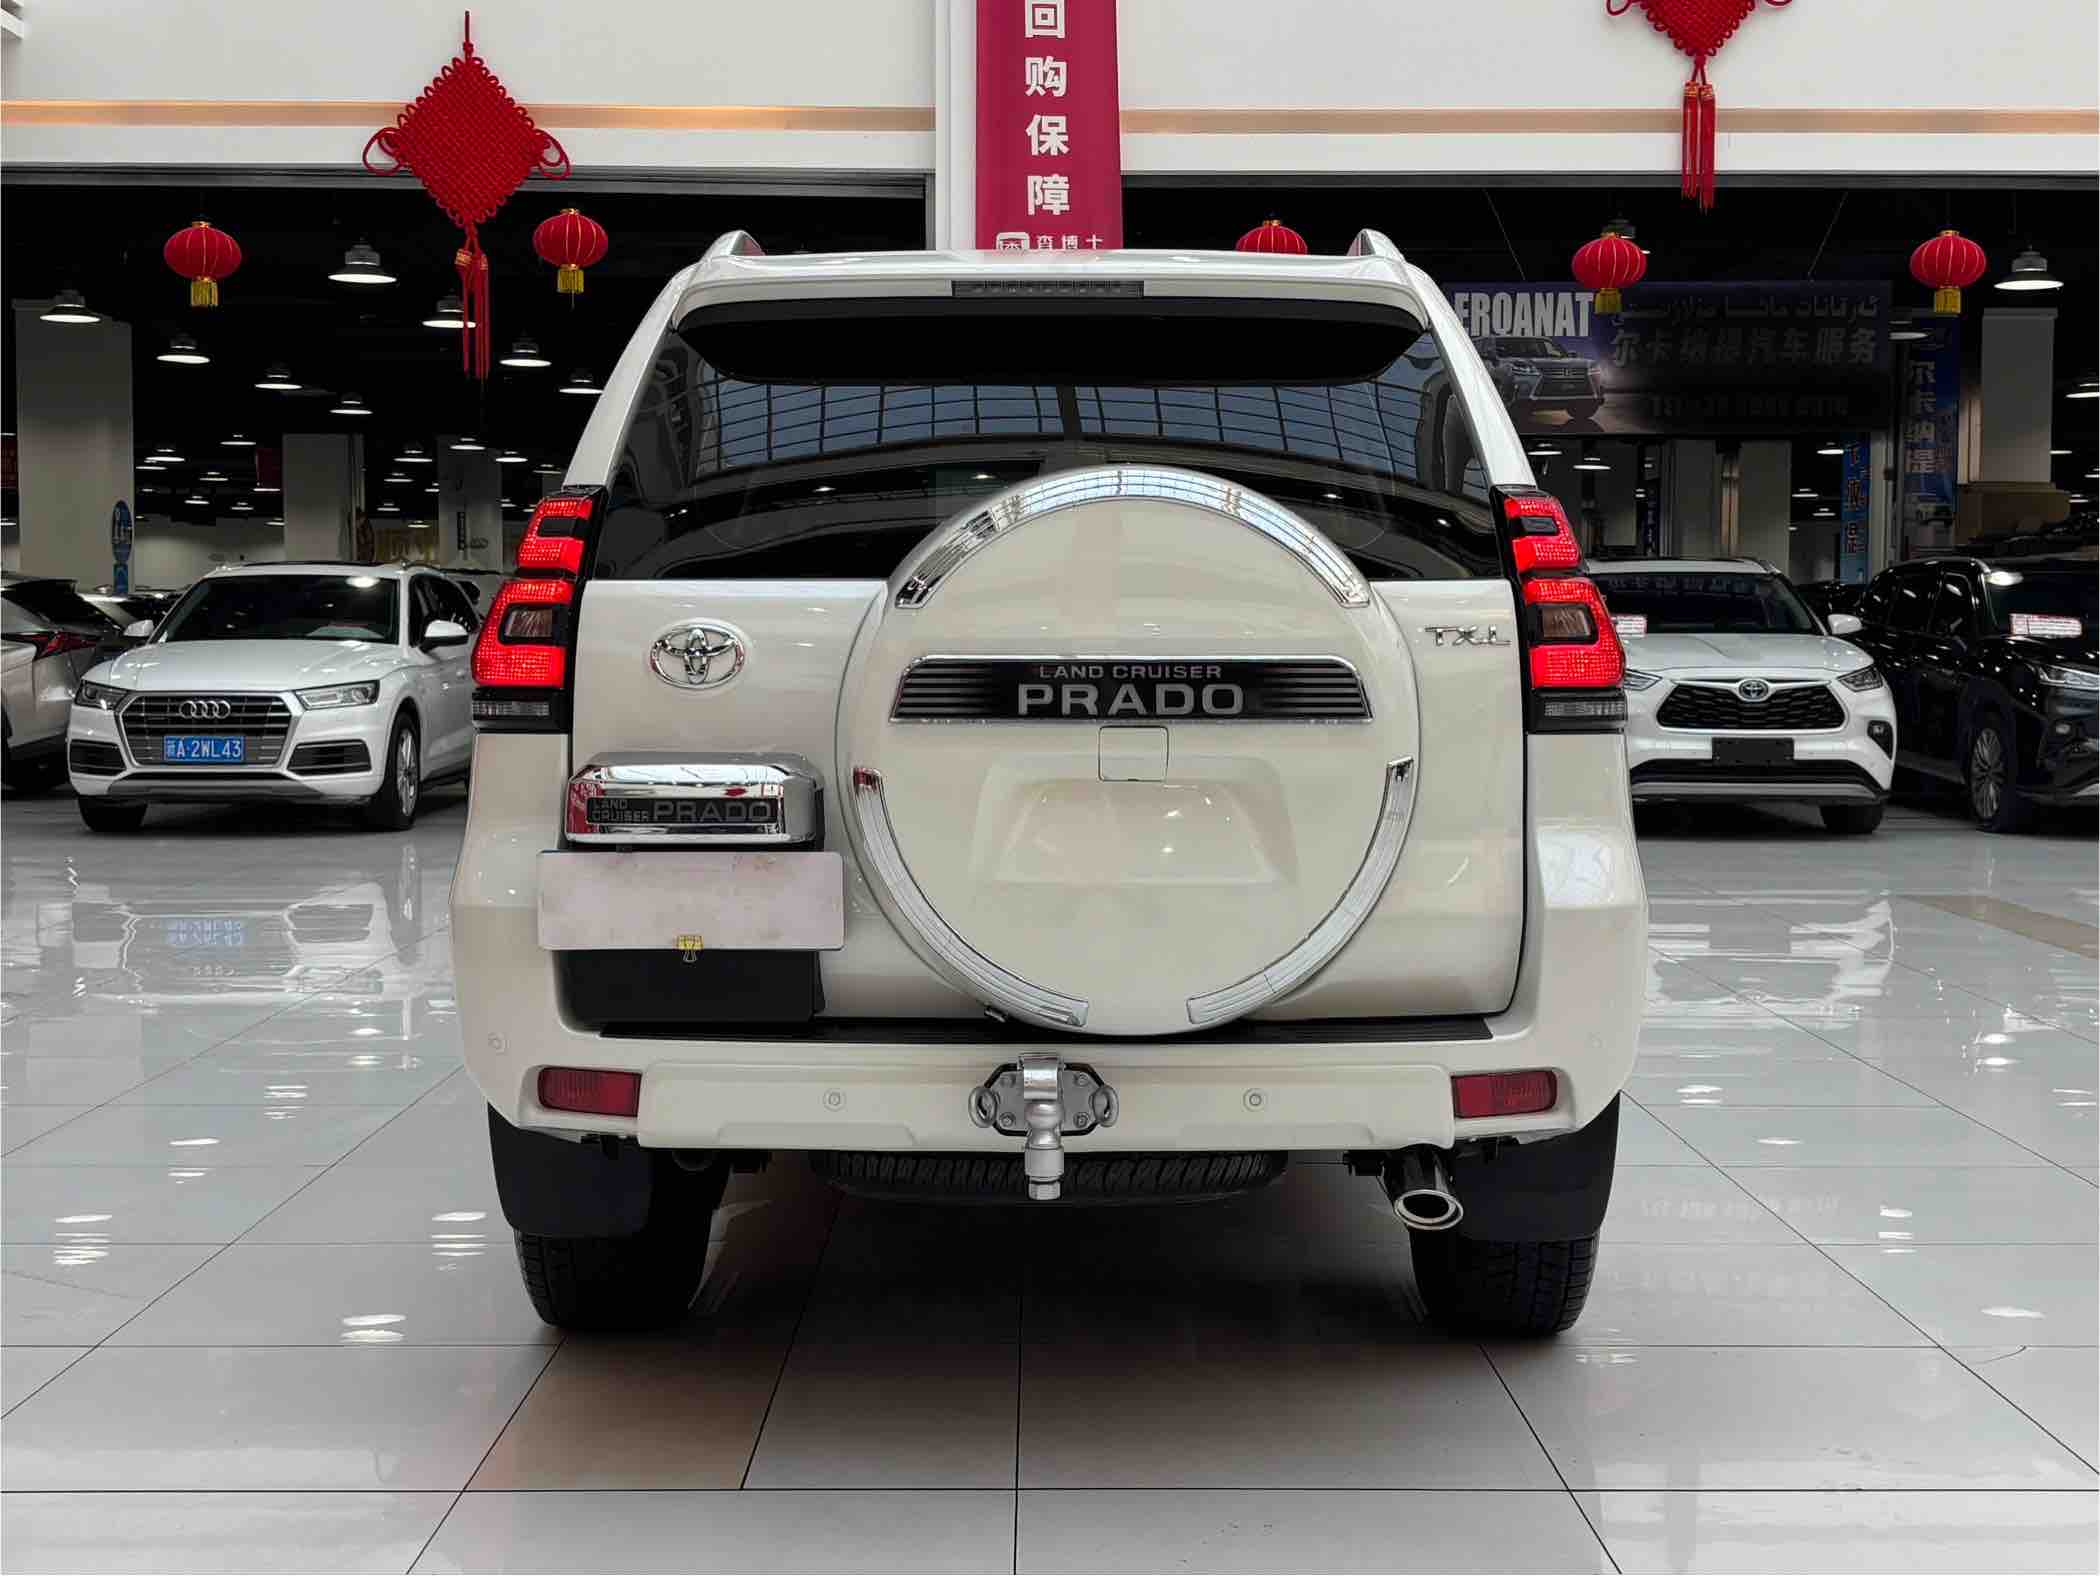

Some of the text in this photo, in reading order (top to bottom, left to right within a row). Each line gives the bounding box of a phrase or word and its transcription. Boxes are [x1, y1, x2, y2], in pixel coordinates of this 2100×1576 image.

[1024, 0, 1070, 216] 回购保障
[1039, 665, 1222, 679] LAND CRUISER
[1017, 683, 1244, 716] PRADO
[592, 799, 629, 809] LAND
[653, 802, 772, 822] PRADO
[591, 810, 649, 822] CRUISER
